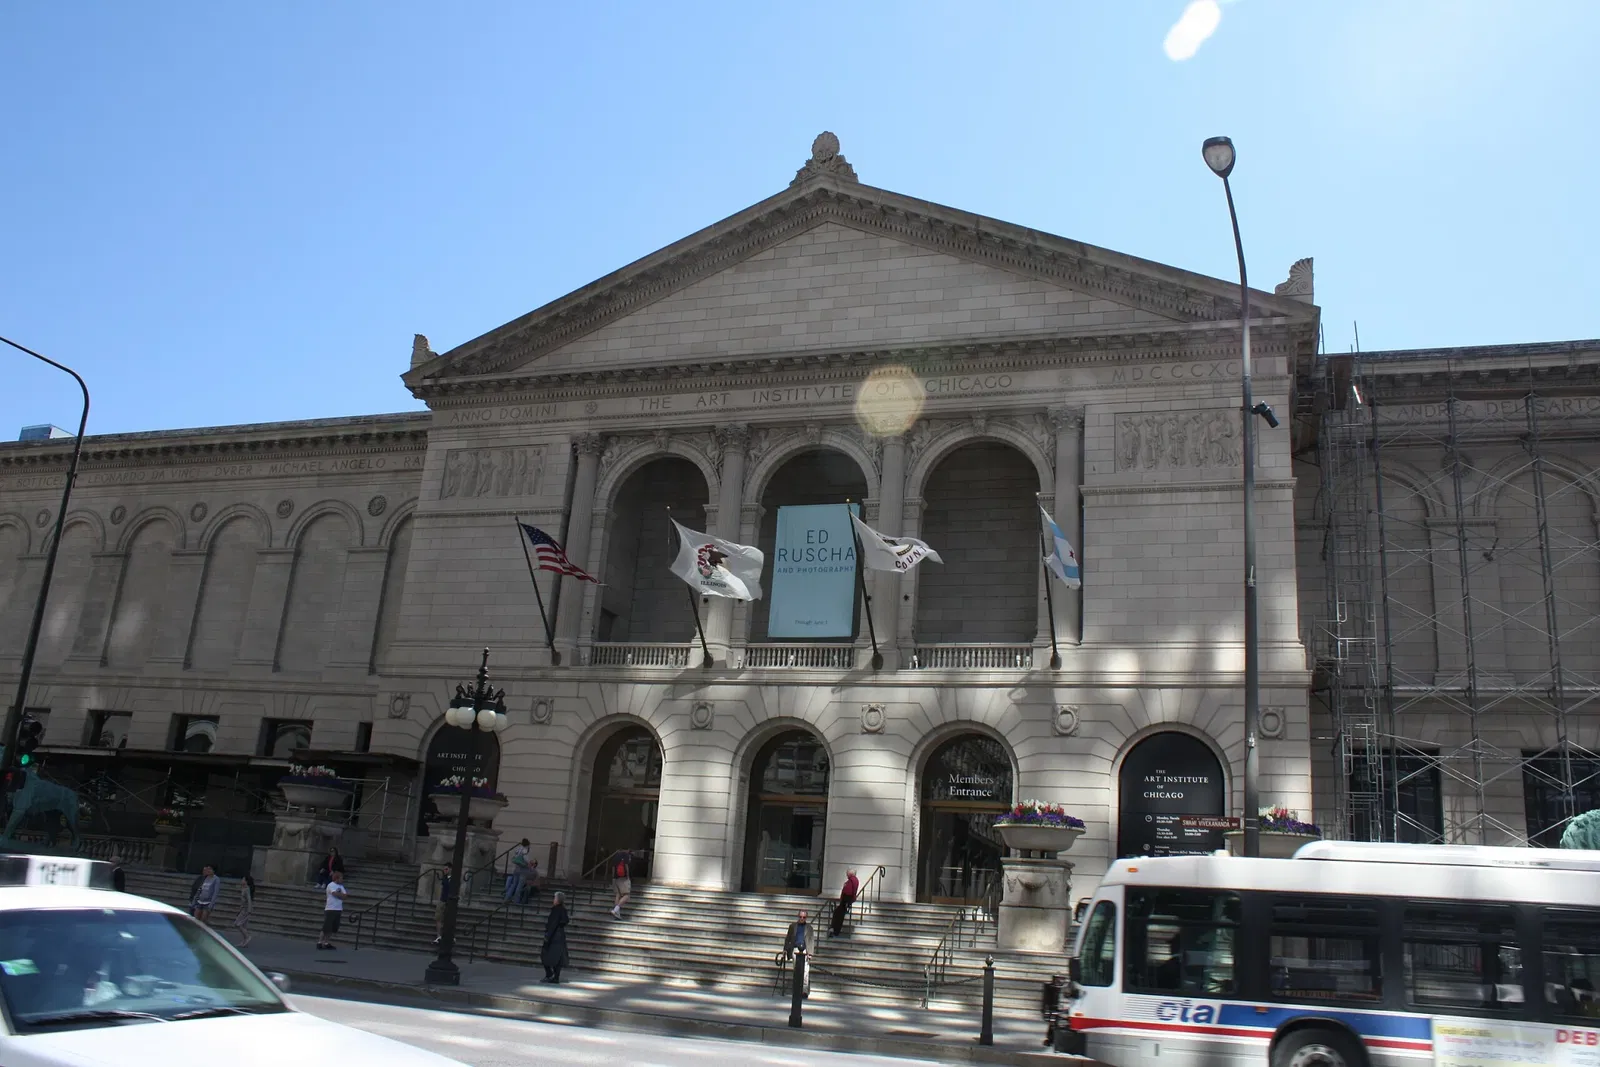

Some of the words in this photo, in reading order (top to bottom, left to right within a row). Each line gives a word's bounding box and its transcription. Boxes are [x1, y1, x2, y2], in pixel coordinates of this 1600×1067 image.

[638, 395, 672, 411] THE
[697, 392, 731, 408] ART
[752, 384, 852, 404] INSTITVTE
[875, 381, 901, 395] OF
[924, 375, 1013, 393] CHICAGO
[450, 408, 493, 423] ANNO
[499, 404, 558, 421] DOMINI
[88, 471, 146, 484] LEONARDO
[152, 470, 165, 481] DA
[214, 465, 253, 477] DVRER
[268, 461, 324, 475] MICHAEL
[329, 457, 386, 472] ANGELO
[806, 529, 829, 544] ED
[777, 546, 855, 563] RUSCHA
[797, 566, 854, 574] PHOTOGRAPHY
[700, 580, 727, 589] ILLINOIS
[948, 773, 994, 785] Members
[1143, 775, 1161, 783] ART
[1163, 776, 1209, 784] INSTITUTE
[949, 785, 993, 797] Entrance
[1143, 791, 1184, 799] CHICAGO
[1156, 999, 1215, 1024] cta
